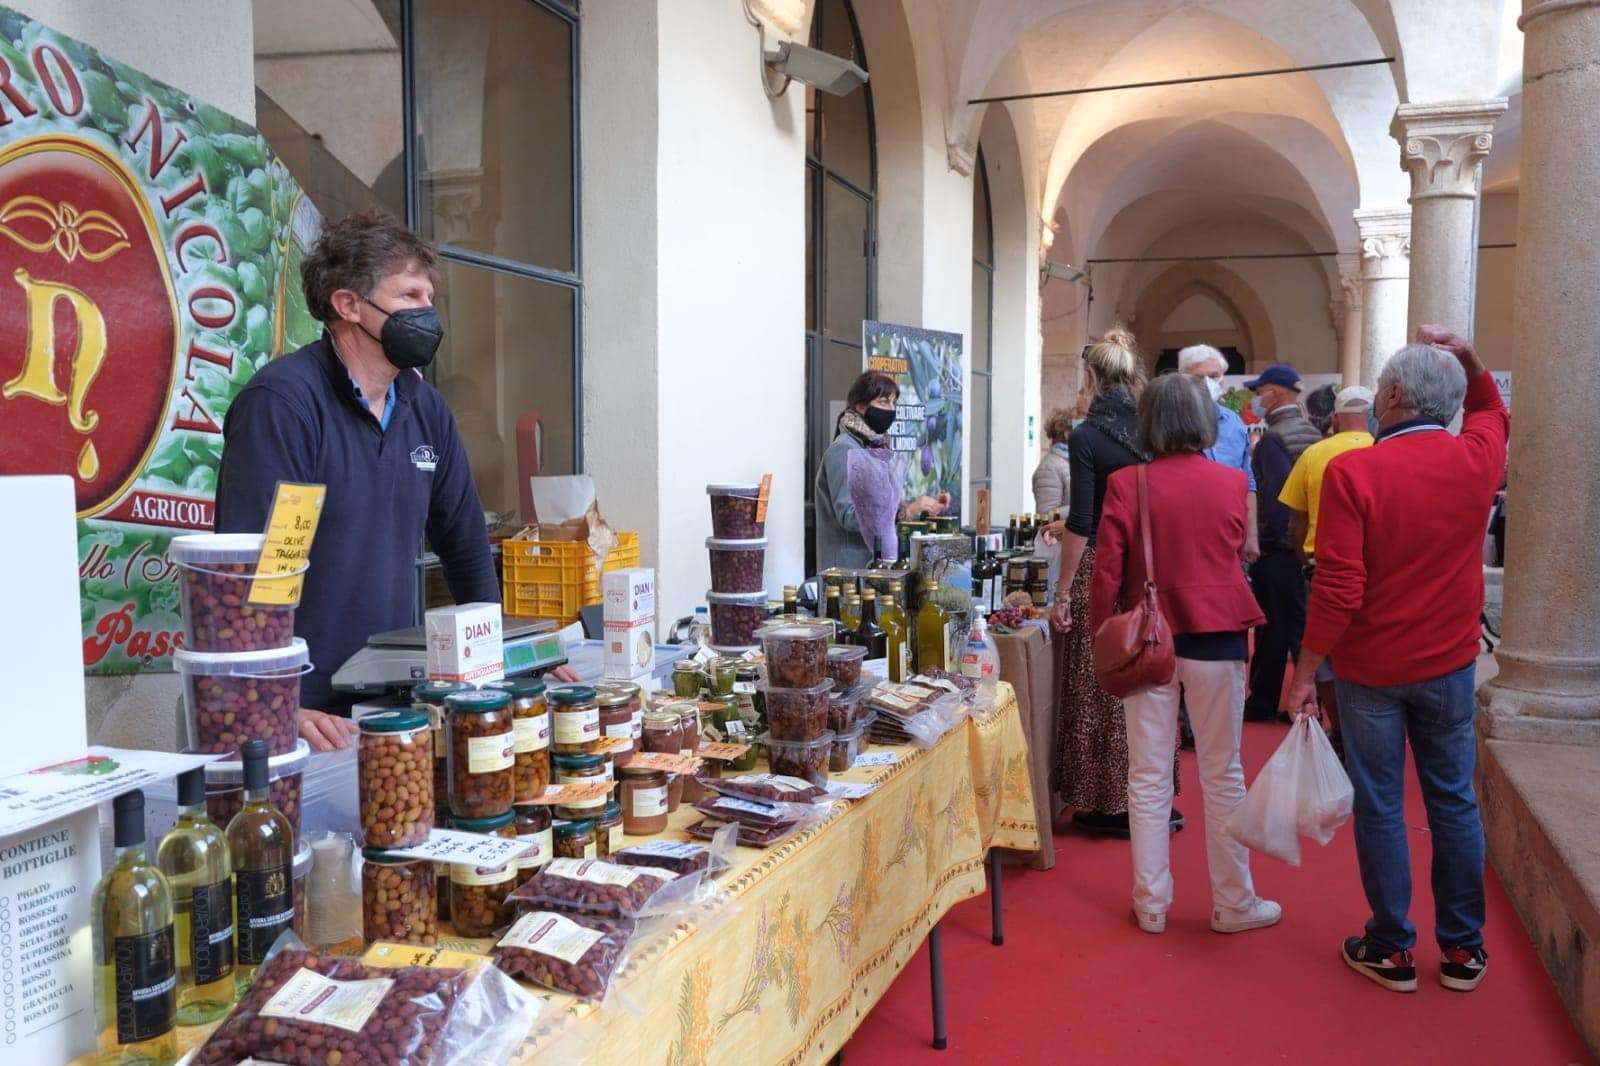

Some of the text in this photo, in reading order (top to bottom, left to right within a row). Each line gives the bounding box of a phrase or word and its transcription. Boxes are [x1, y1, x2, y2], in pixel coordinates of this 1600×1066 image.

[124, 98, 236, 434] NICOLA
[79, 543, 115, 580] llo
[82, 601, 185, 667] Pass
[0, 829, 69, 861] CONTIENE
[3, 844, 78, 879] BOTTIGLIE
